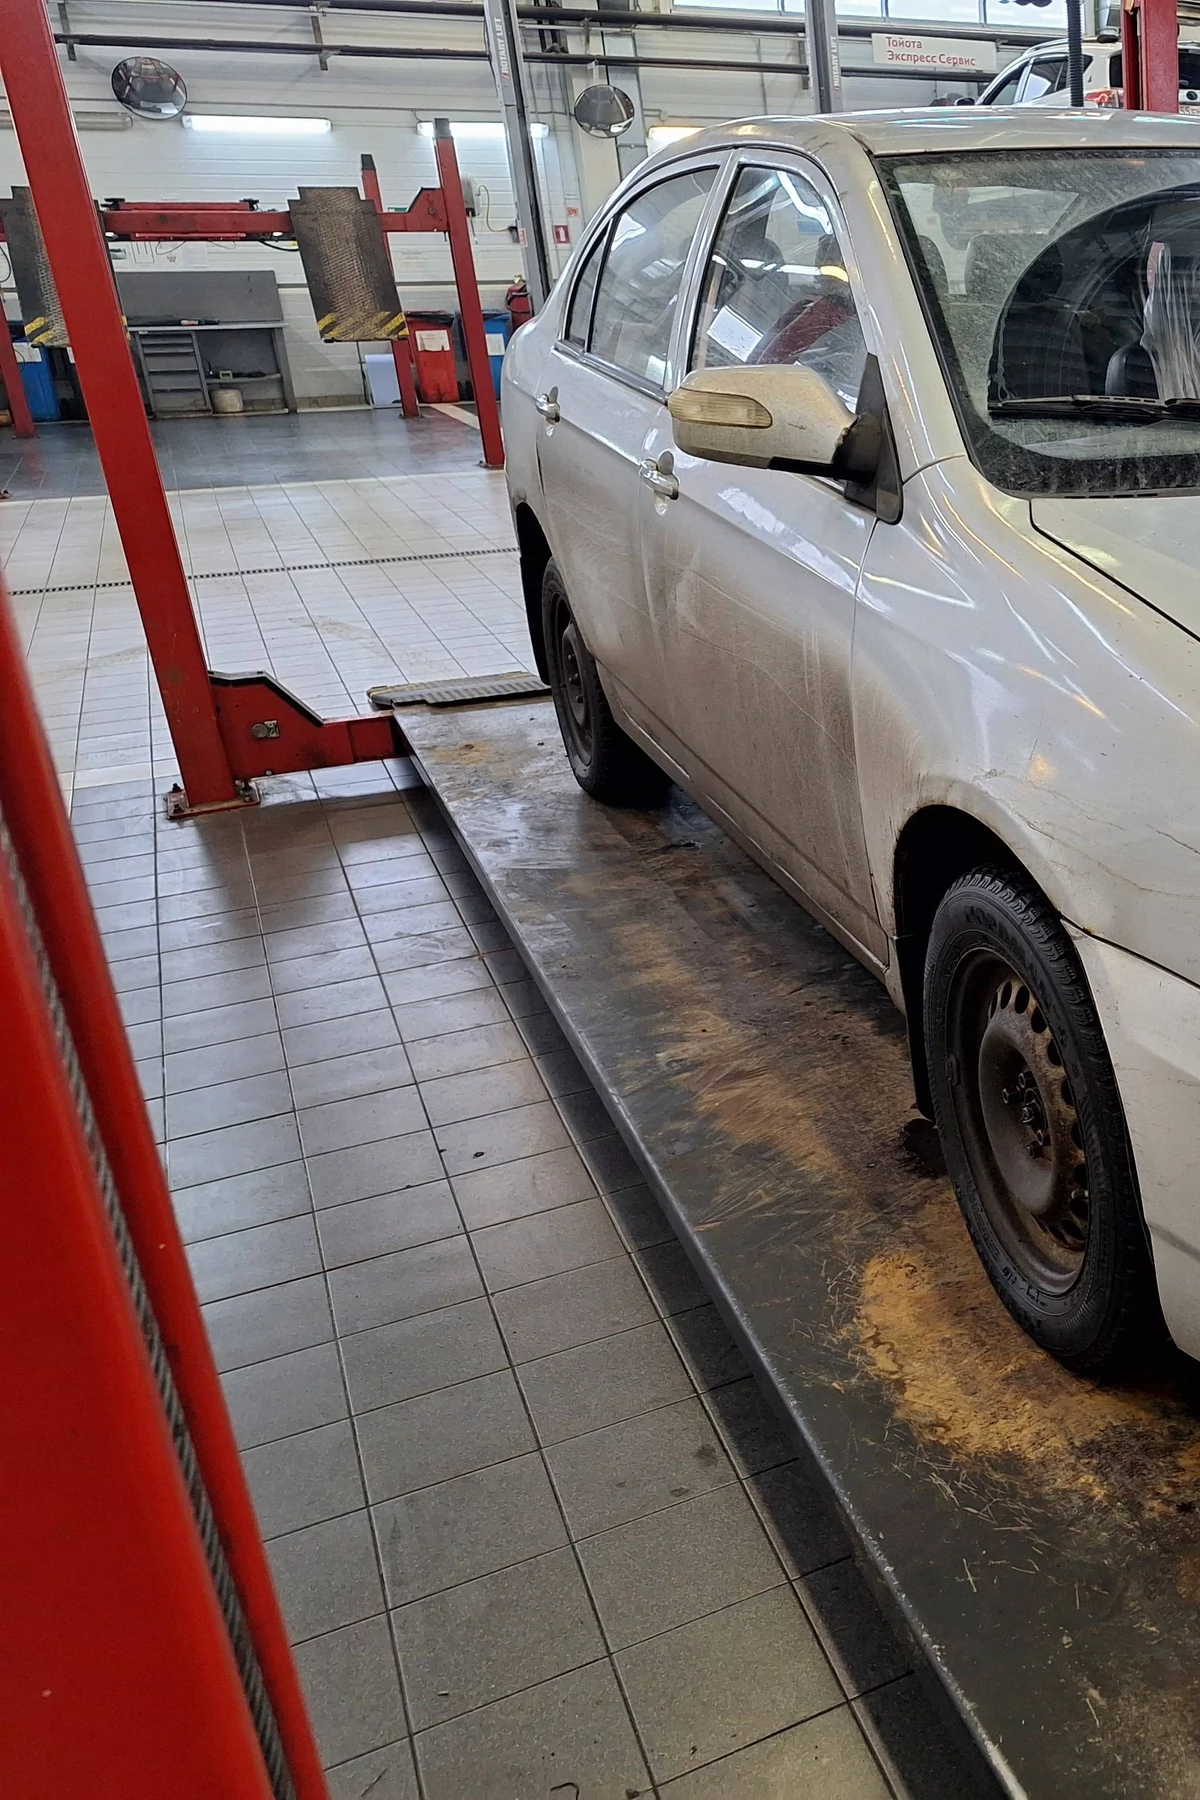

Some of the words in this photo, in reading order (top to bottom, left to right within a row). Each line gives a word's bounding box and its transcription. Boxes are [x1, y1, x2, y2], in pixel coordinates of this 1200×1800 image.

[494, 17, 503, 36] LIFT
[886, 36, 922, 49] Тойота
[499, 38, 508, 73] ROTARY
[887, 50, 937, 64] Экспресс
[938, 54, 976, 67] Сервис
[832, 54, 840, 87] ROTARY
